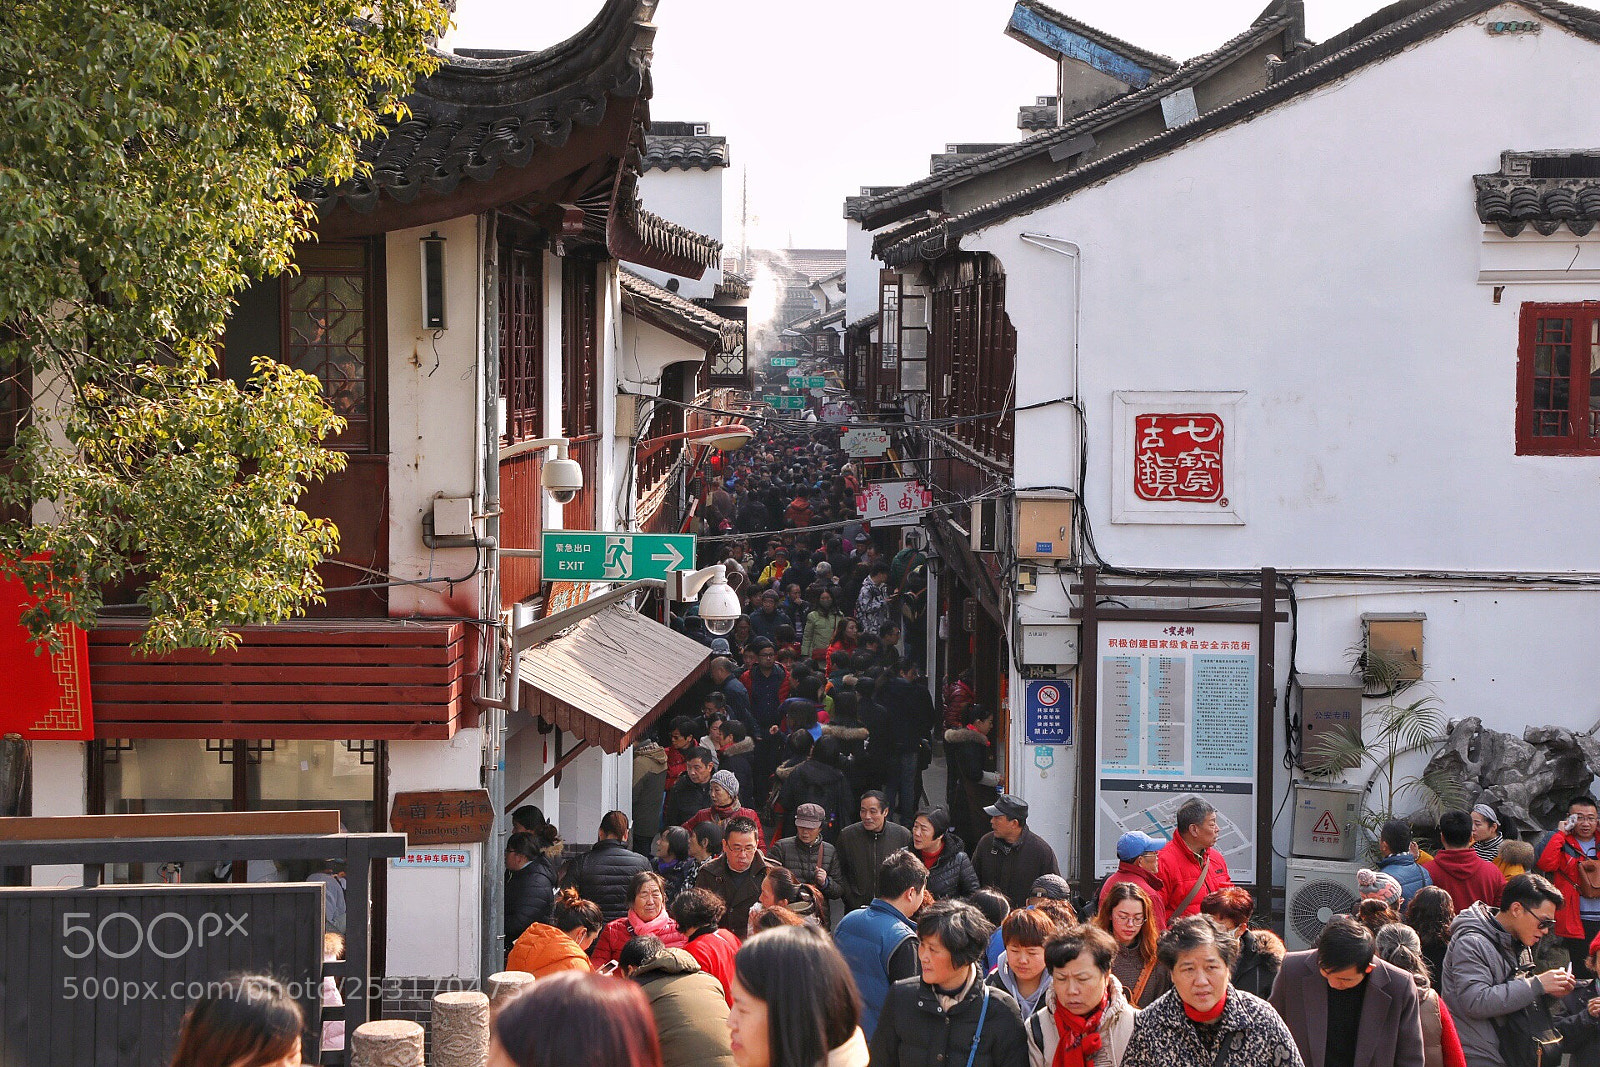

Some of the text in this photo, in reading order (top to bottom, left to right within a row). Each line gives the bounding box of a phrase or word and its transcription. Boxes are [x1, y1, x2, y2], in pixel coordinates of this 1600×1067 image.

[878, 492, 913, 513] 自由
[558, 561, 585, 571] EXIT
[1108, 638, 1251, 651] 积极创建国家级食品安全示范街
[1314, 711, 1351, 720] 公安专用
[410, 800, 474, 819] 南东街
[414, 825, 459, 836] Nandong
[461, 824, 473, 833] St.
